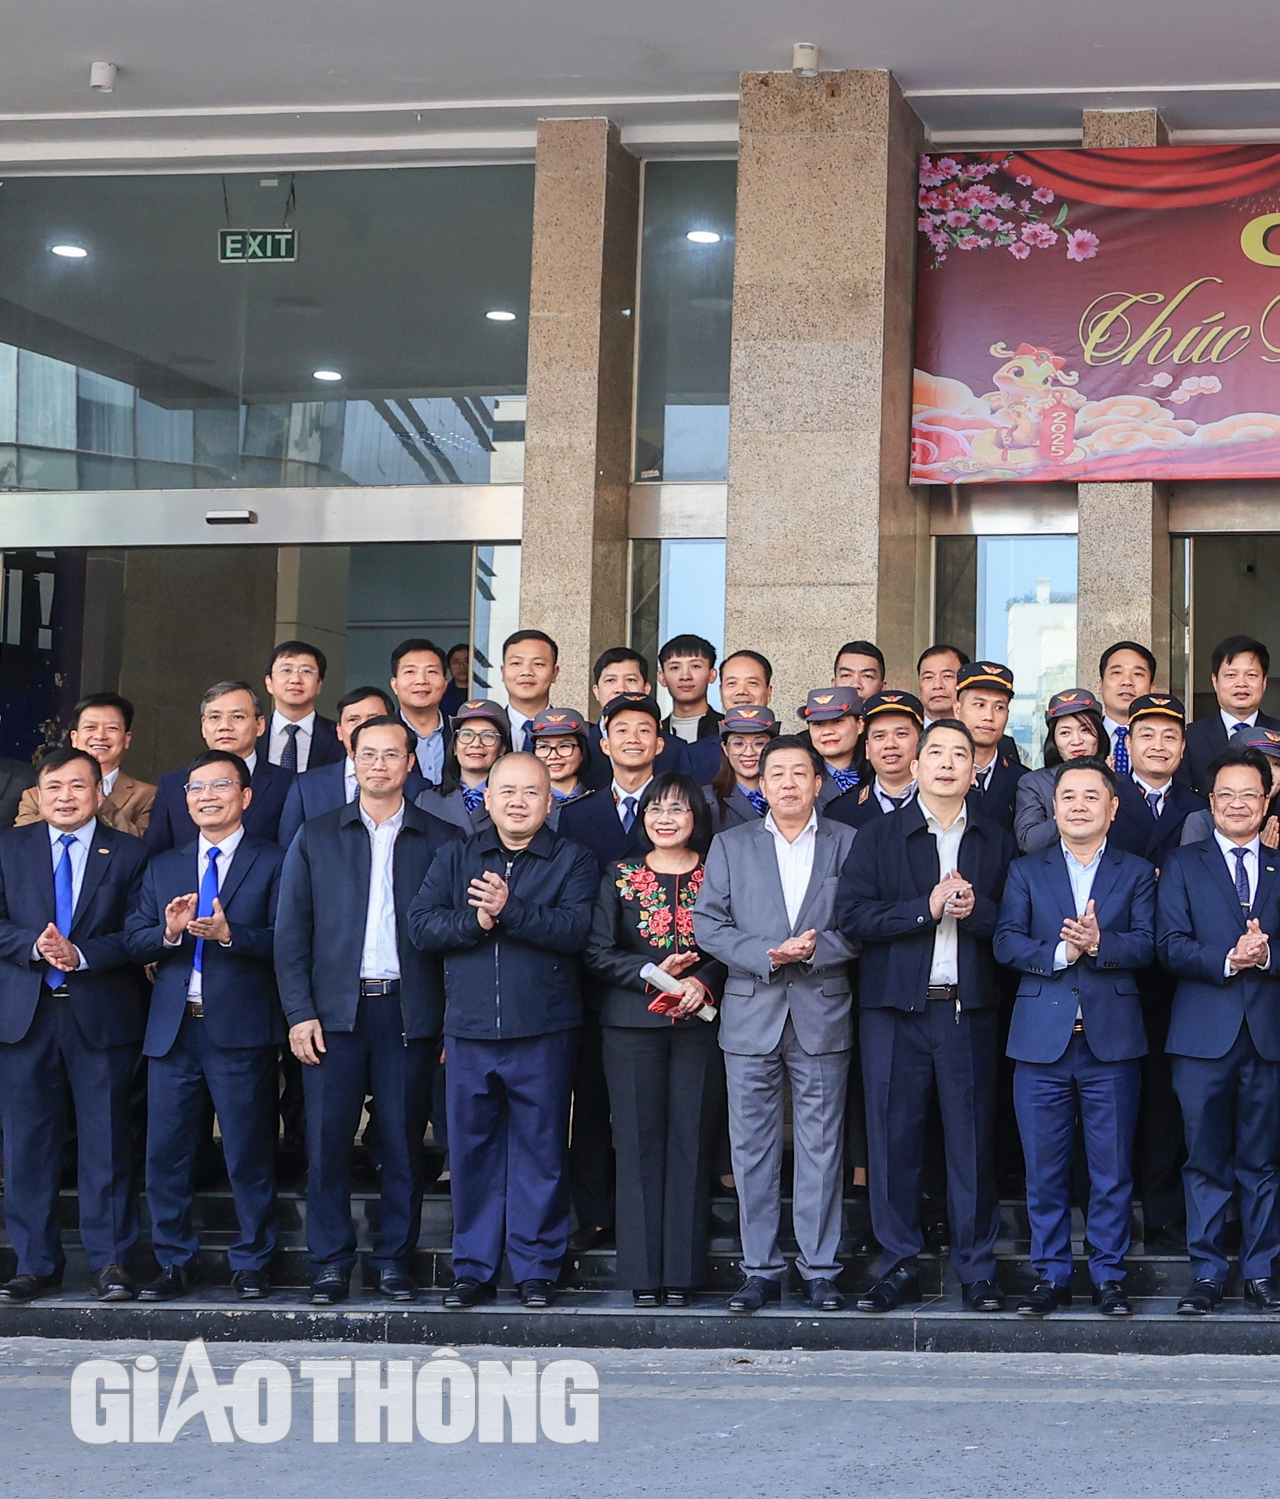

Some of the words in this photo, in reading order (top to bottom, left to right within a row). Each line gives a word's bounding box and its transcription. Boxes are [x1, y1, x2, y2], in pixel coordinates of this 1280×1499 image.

[226, 235, 292, 257] EXIT
[1079, 277, 1252, 367] Chúc
[1050, 411, 1068, 457] 2025
